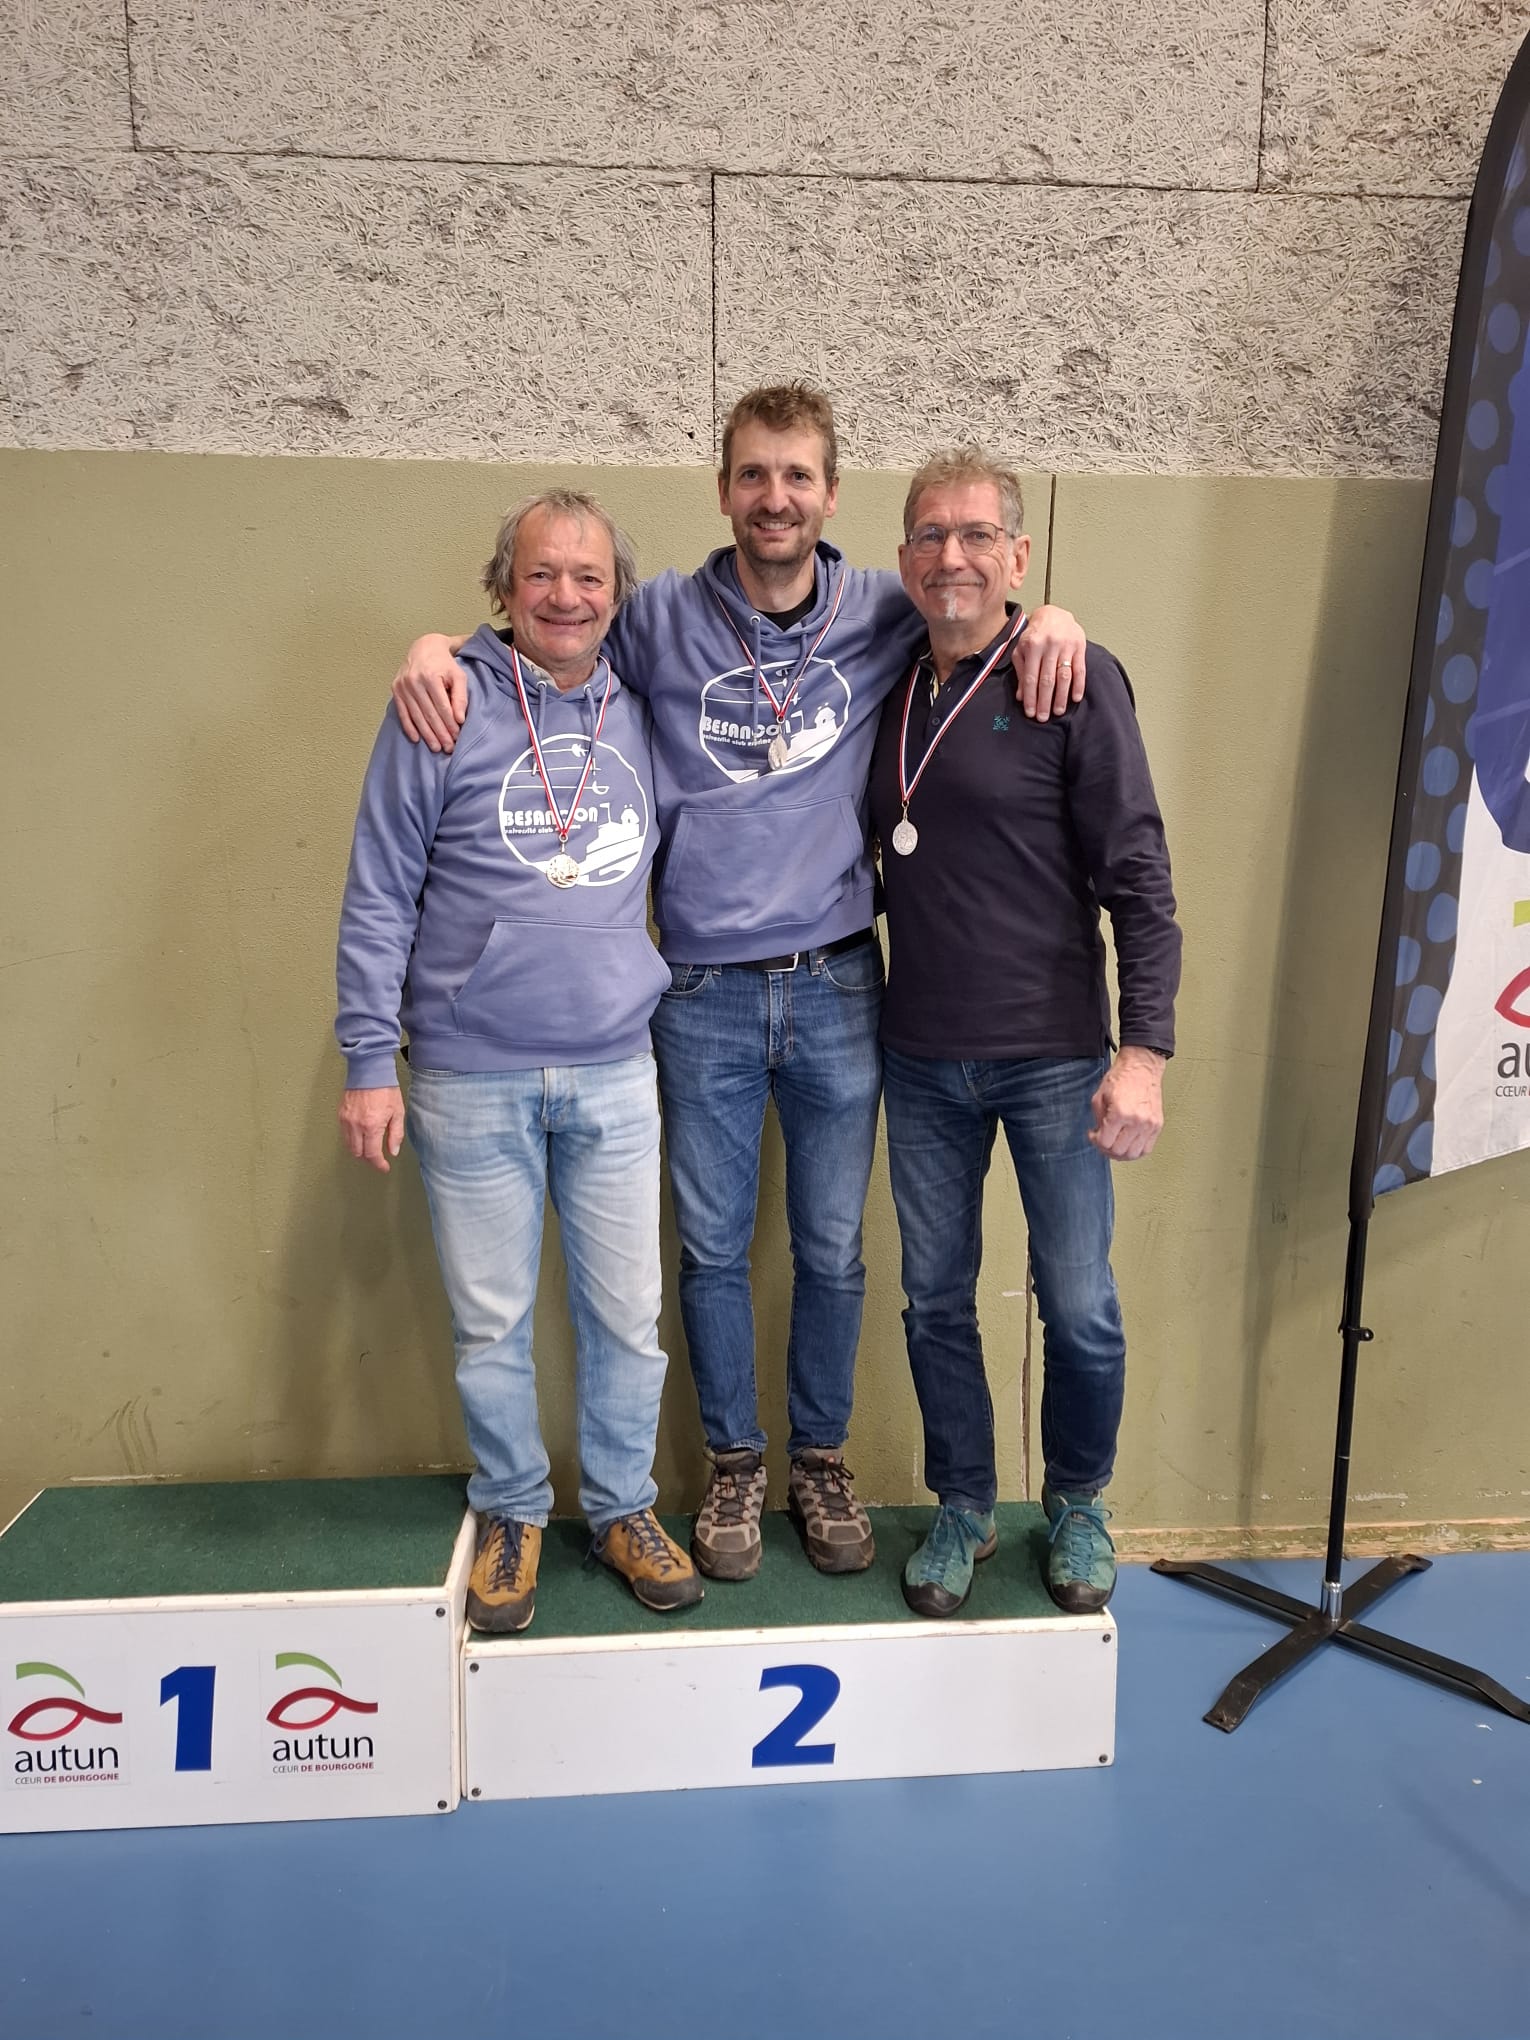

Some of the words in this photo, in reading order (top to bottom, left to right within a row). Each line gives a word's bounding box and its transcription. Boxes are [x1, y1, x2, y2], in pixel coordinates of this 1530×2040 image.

[1495, 1085, 1528, 1098] CŒUR
[160, 1665, 217, 1772] 1
[751, 1663, 841, 1769] 2
[14, 1744, 119, 1773] autun
[272, 1733, 374, 1762] autun
[14, 1776, 42, 1785] CŒUR
[43, 1775, 57, 1784] DE
[58, 1772, 120, 1784] BOURGOGNE
[272, 1764, 300, 1775] CŒUR
[300, 1764, 314, 1773] DE
[315, 1761, 375, 1772] BOURGOGNE
